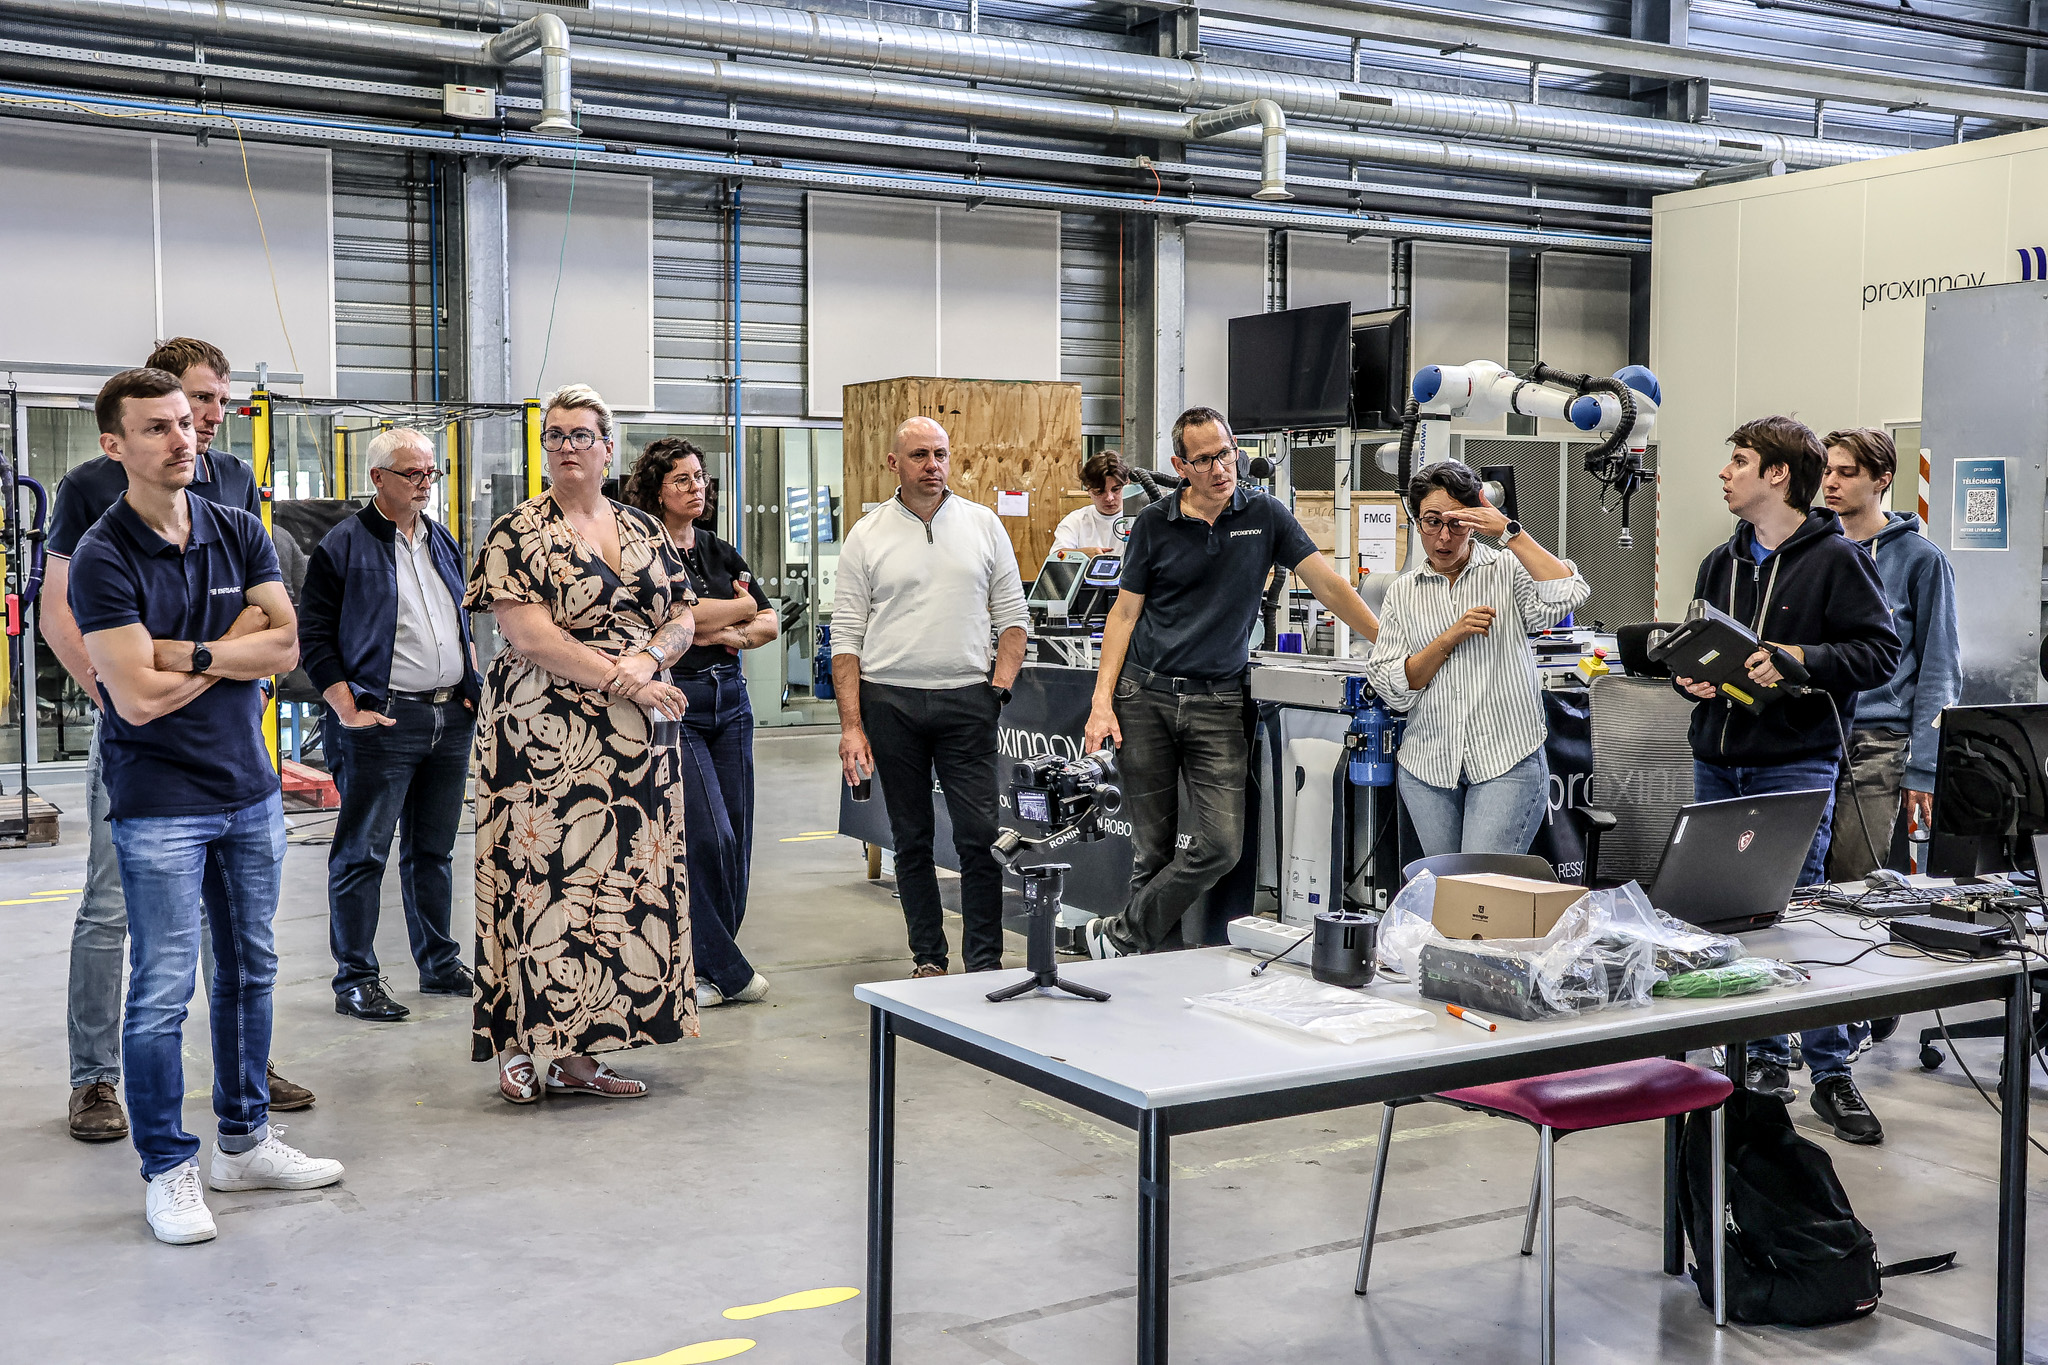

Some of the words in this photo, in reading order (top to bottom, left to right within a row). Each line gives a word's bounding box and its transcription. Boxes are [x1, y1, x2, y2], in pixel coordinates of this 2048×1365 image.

[1419, 423, 1427, 468] YASKAWA
[1364, 513, 1391, 523] FMCG
[1230, 529, 1262, 538] proxinnov
[1048, 827, 1081, 849] RONIN
